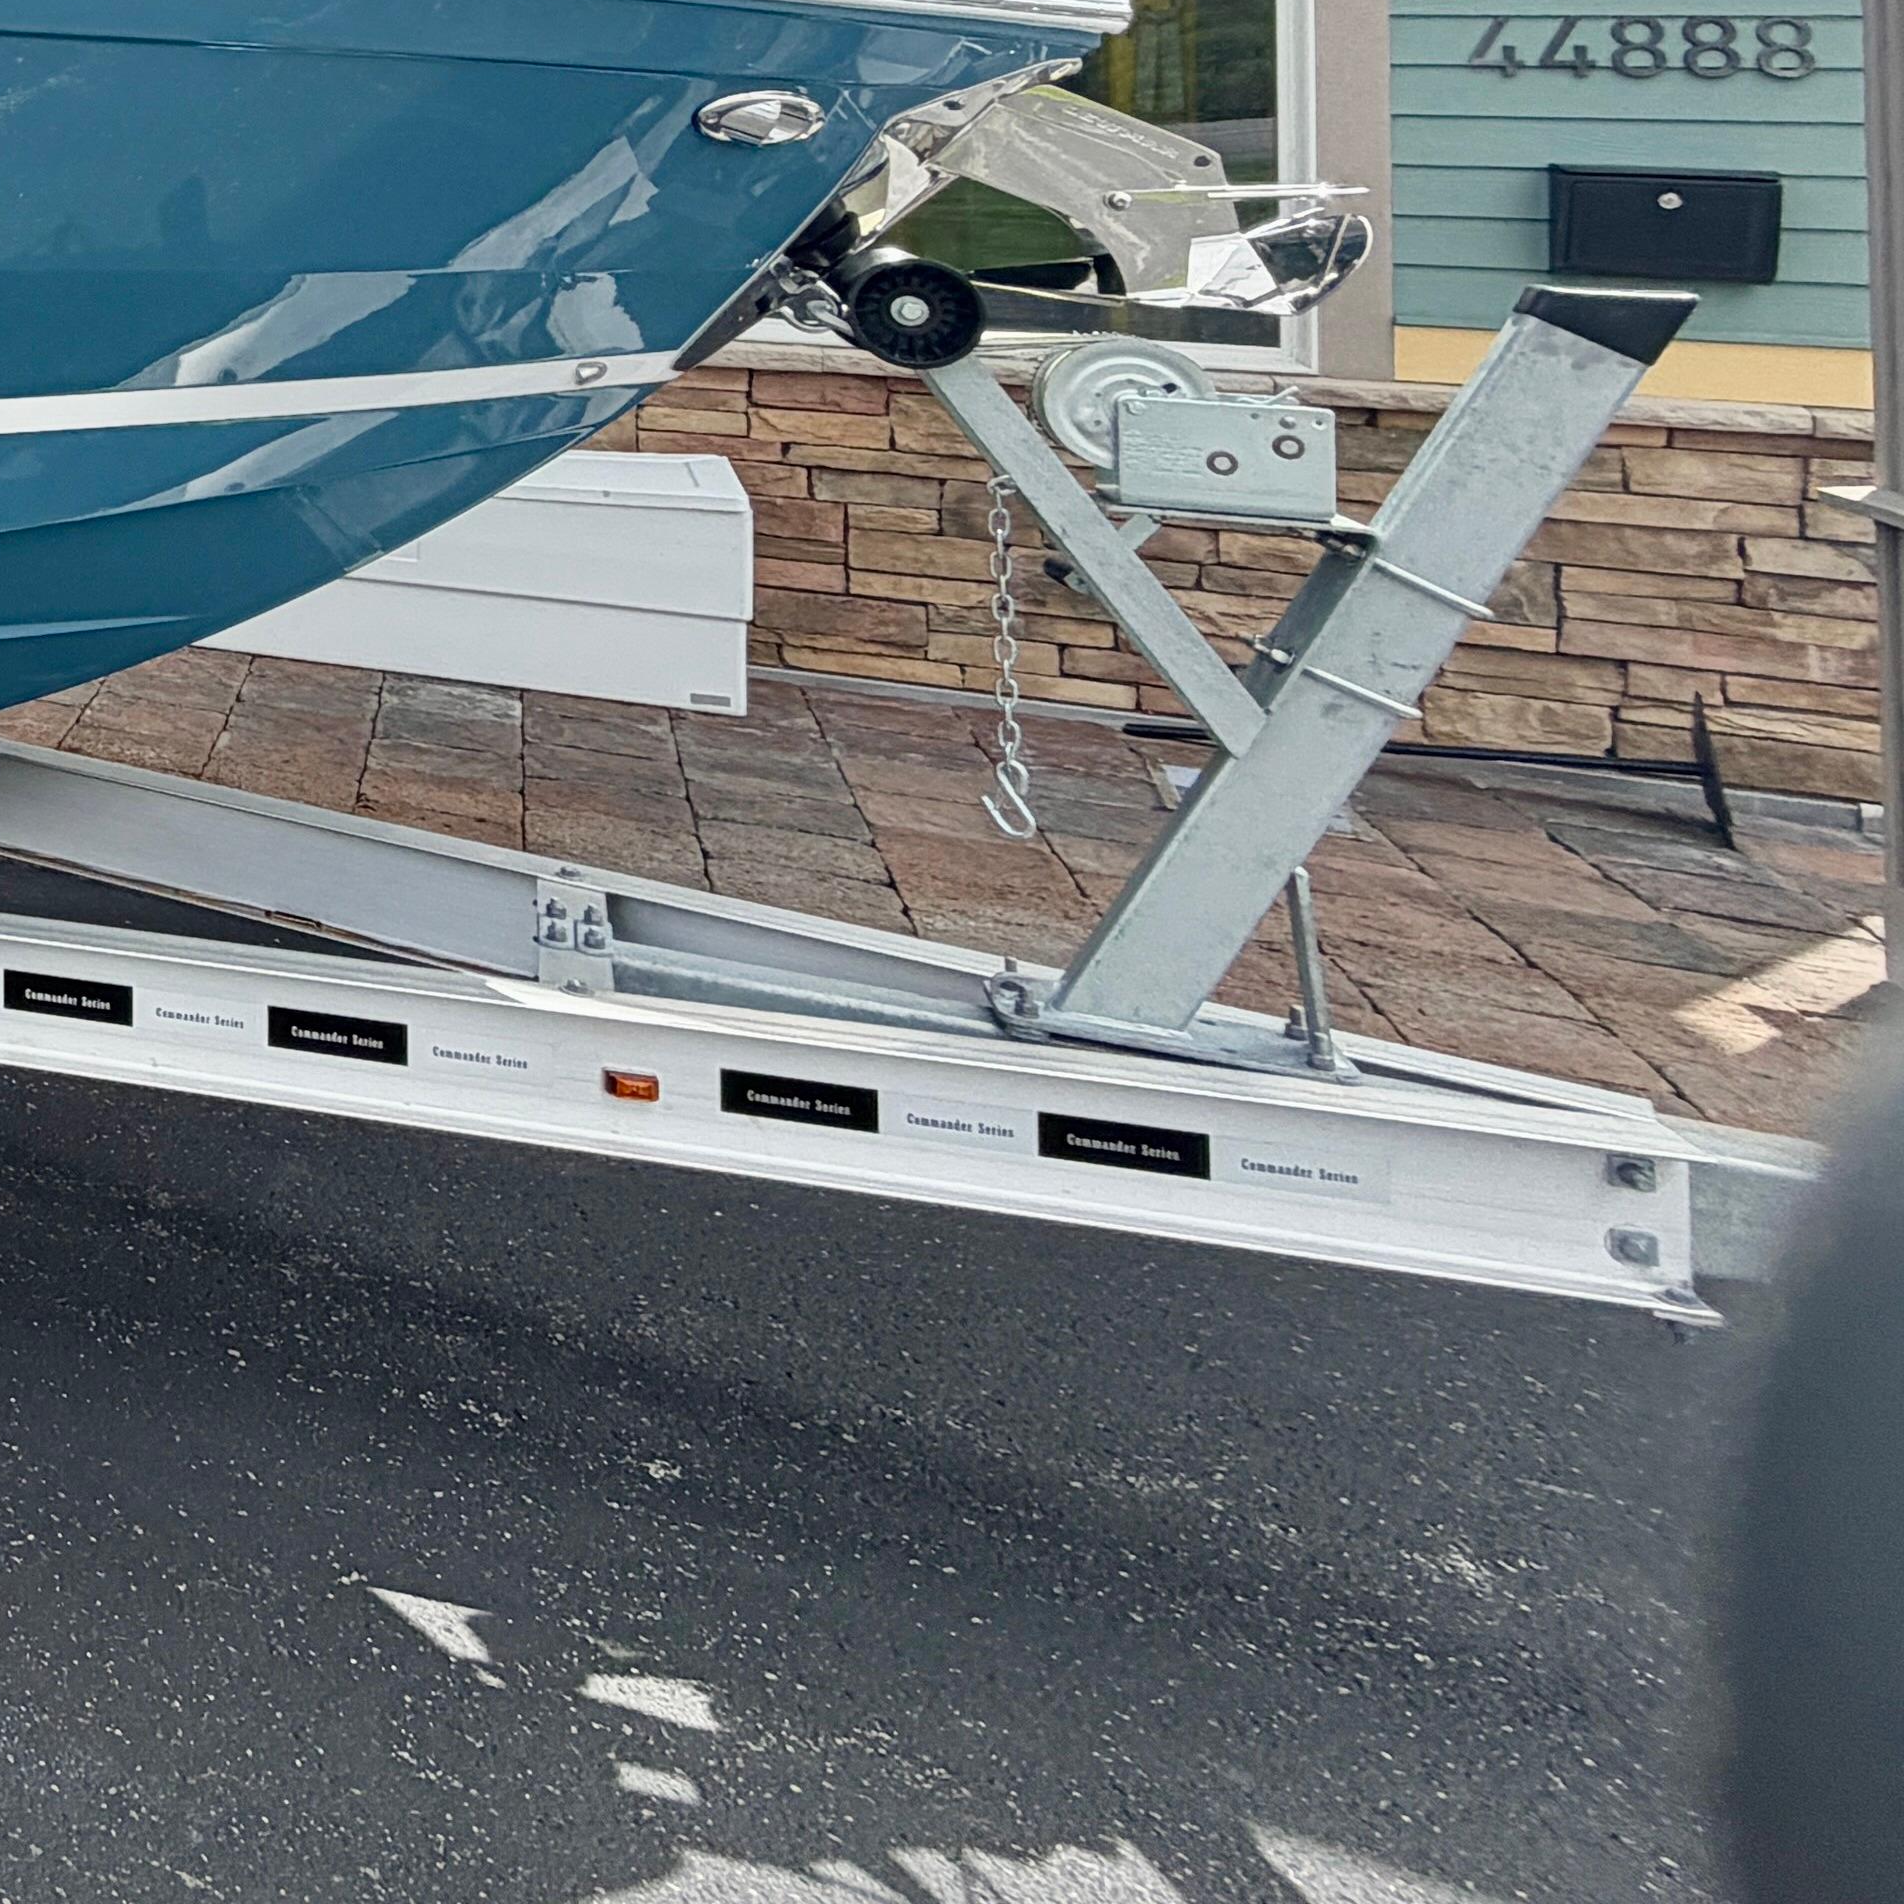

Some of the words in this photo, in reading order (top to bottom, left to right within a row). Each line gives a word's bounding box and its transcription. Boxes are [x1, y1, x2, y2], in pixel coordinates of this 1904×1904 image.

[1467, 15, 1817, 80] 44888
[24, 988, 78, 1006] Commander
[155, 1007, 210, 1024] Commander
[291, 1025, 348, 1045] Commander
[432, 1045, 491, 1065] Commander
[746, 1089, 811, 1111] Commander
[814, 1099, 851, 1116] Series
[906, 1112, 973, 1133] Commander
[978, 1122, 1015, 1138] Series
[1066, 1133, 1137, 1156] Commander
[1141, 1143, 1181, 1161] Series
[1241, 1158, 1313, 1179] Commander
[1318, 1168, 1359, 1185] Series
